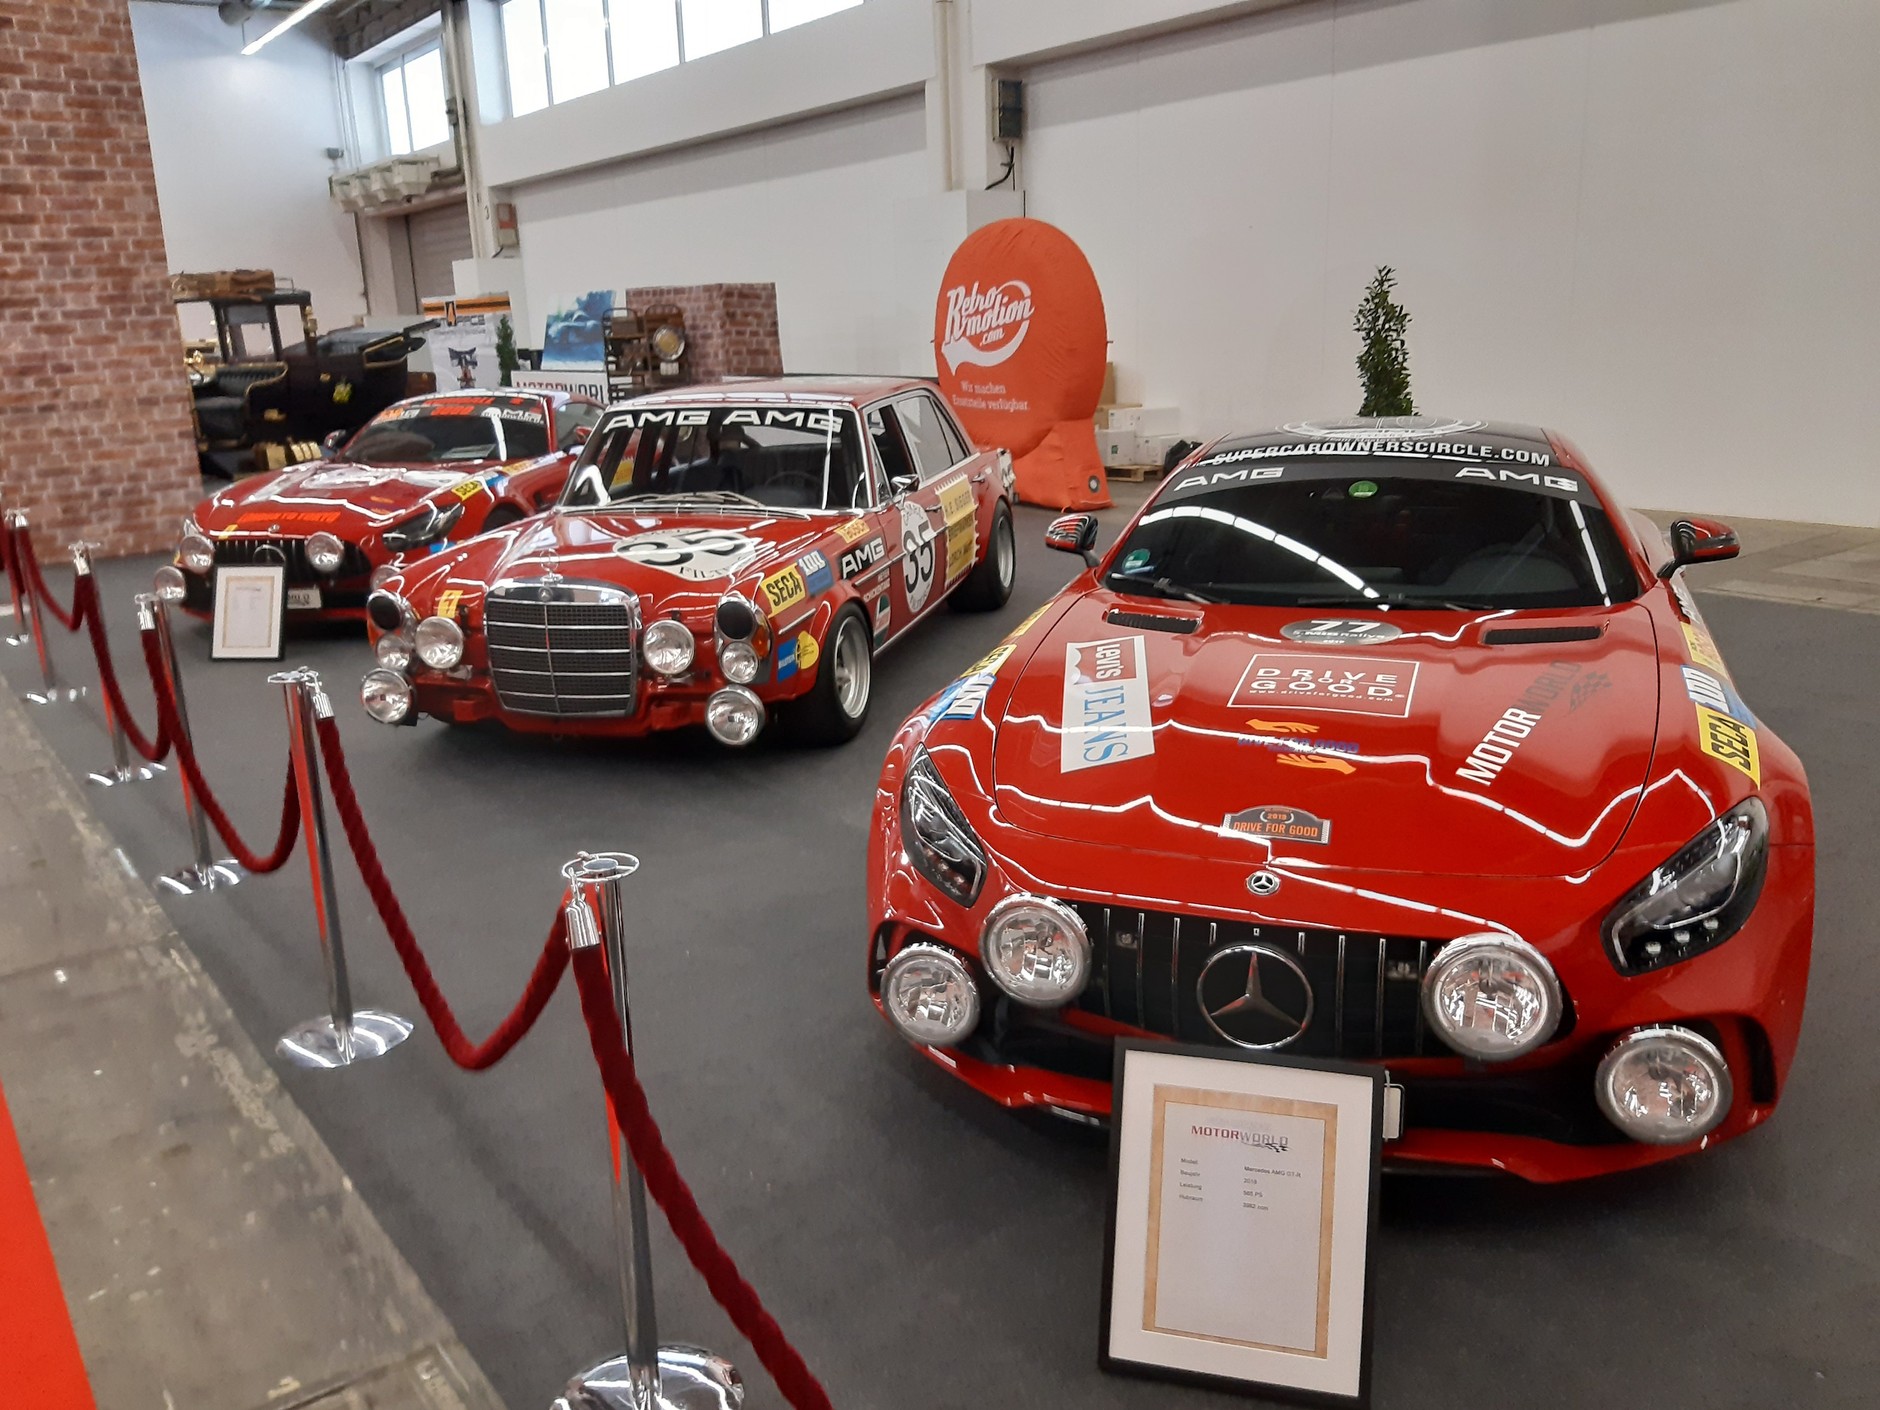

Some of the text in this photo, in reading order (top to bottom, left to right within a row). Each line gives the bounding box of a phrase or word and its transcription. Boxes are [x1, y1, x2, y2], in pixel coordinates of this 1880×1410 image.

[945, 281, 998, 345] Retro
[966, 294, 1035, 336] motion
[603, 410, 843, 433] AMG AMG
[1212, 440, 1550, 467] SUPERCAROWNERSCIRCLE.COM
[1174, 467, 1579, 492] AMG AMG
[799, 550, 826, 576] 100
[842, 537, 885, 580] AMG
[903, 520, 934, 594] 35
[766, 571, 803, 607] SECA
[1311, 620, 1380, 633] 77
[1251, 680, 1394, 697] GOOD
[1257, 668, 1399, 684] DRIVE
[1300, 675, 1353, 685] FOR
[1083, 685, 1129, 763] JEANS
[1707, 714, 1752, 772] SECA
[1233, 821, 1319, 837] DRIVE FOR GOOD
[1191, 1125, 1289, 1147] MOTORWORLD
